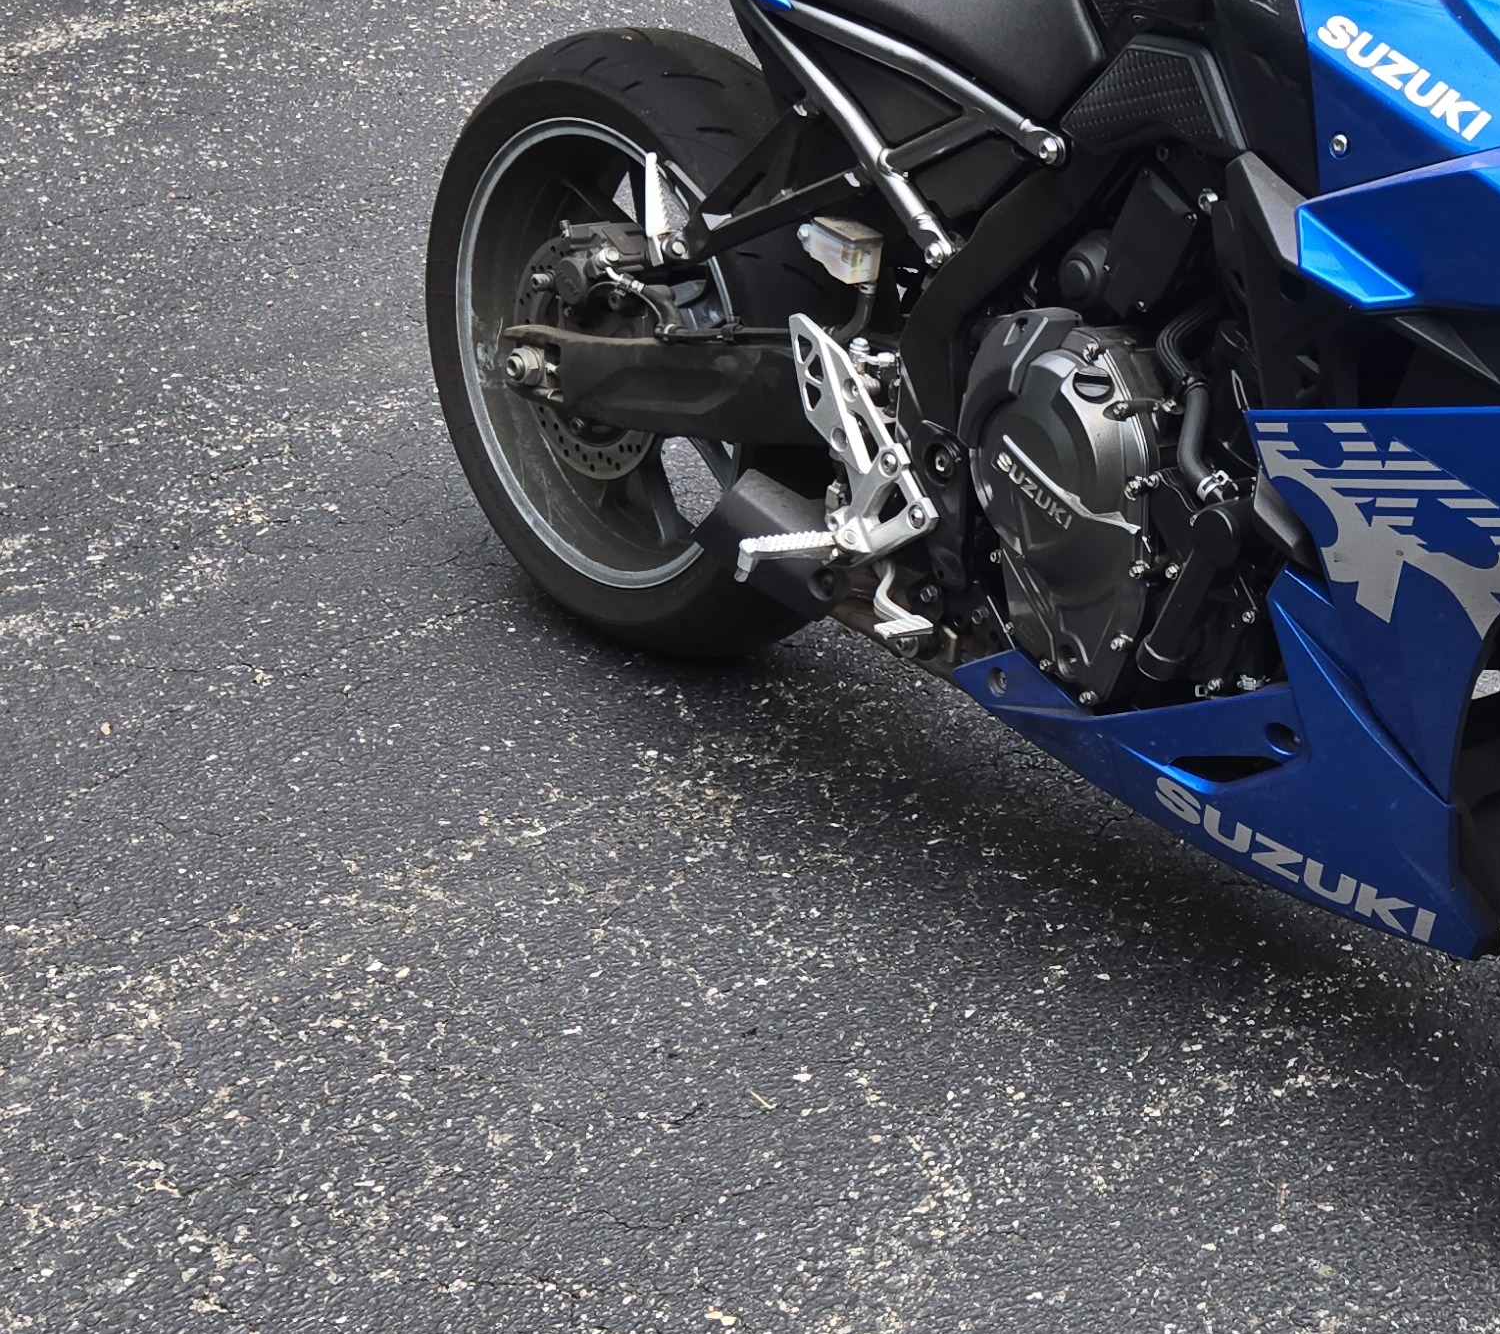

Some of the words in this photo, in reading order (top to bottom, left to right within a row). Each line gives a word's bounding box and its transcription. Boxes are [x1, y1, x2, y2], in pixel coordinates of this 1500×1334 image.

[1317, 15, 1492, 142] SUZUKI
[997, 451, 1073, 530] SUZUKI
[1155, 777, 1437, 944] SUZUKI
